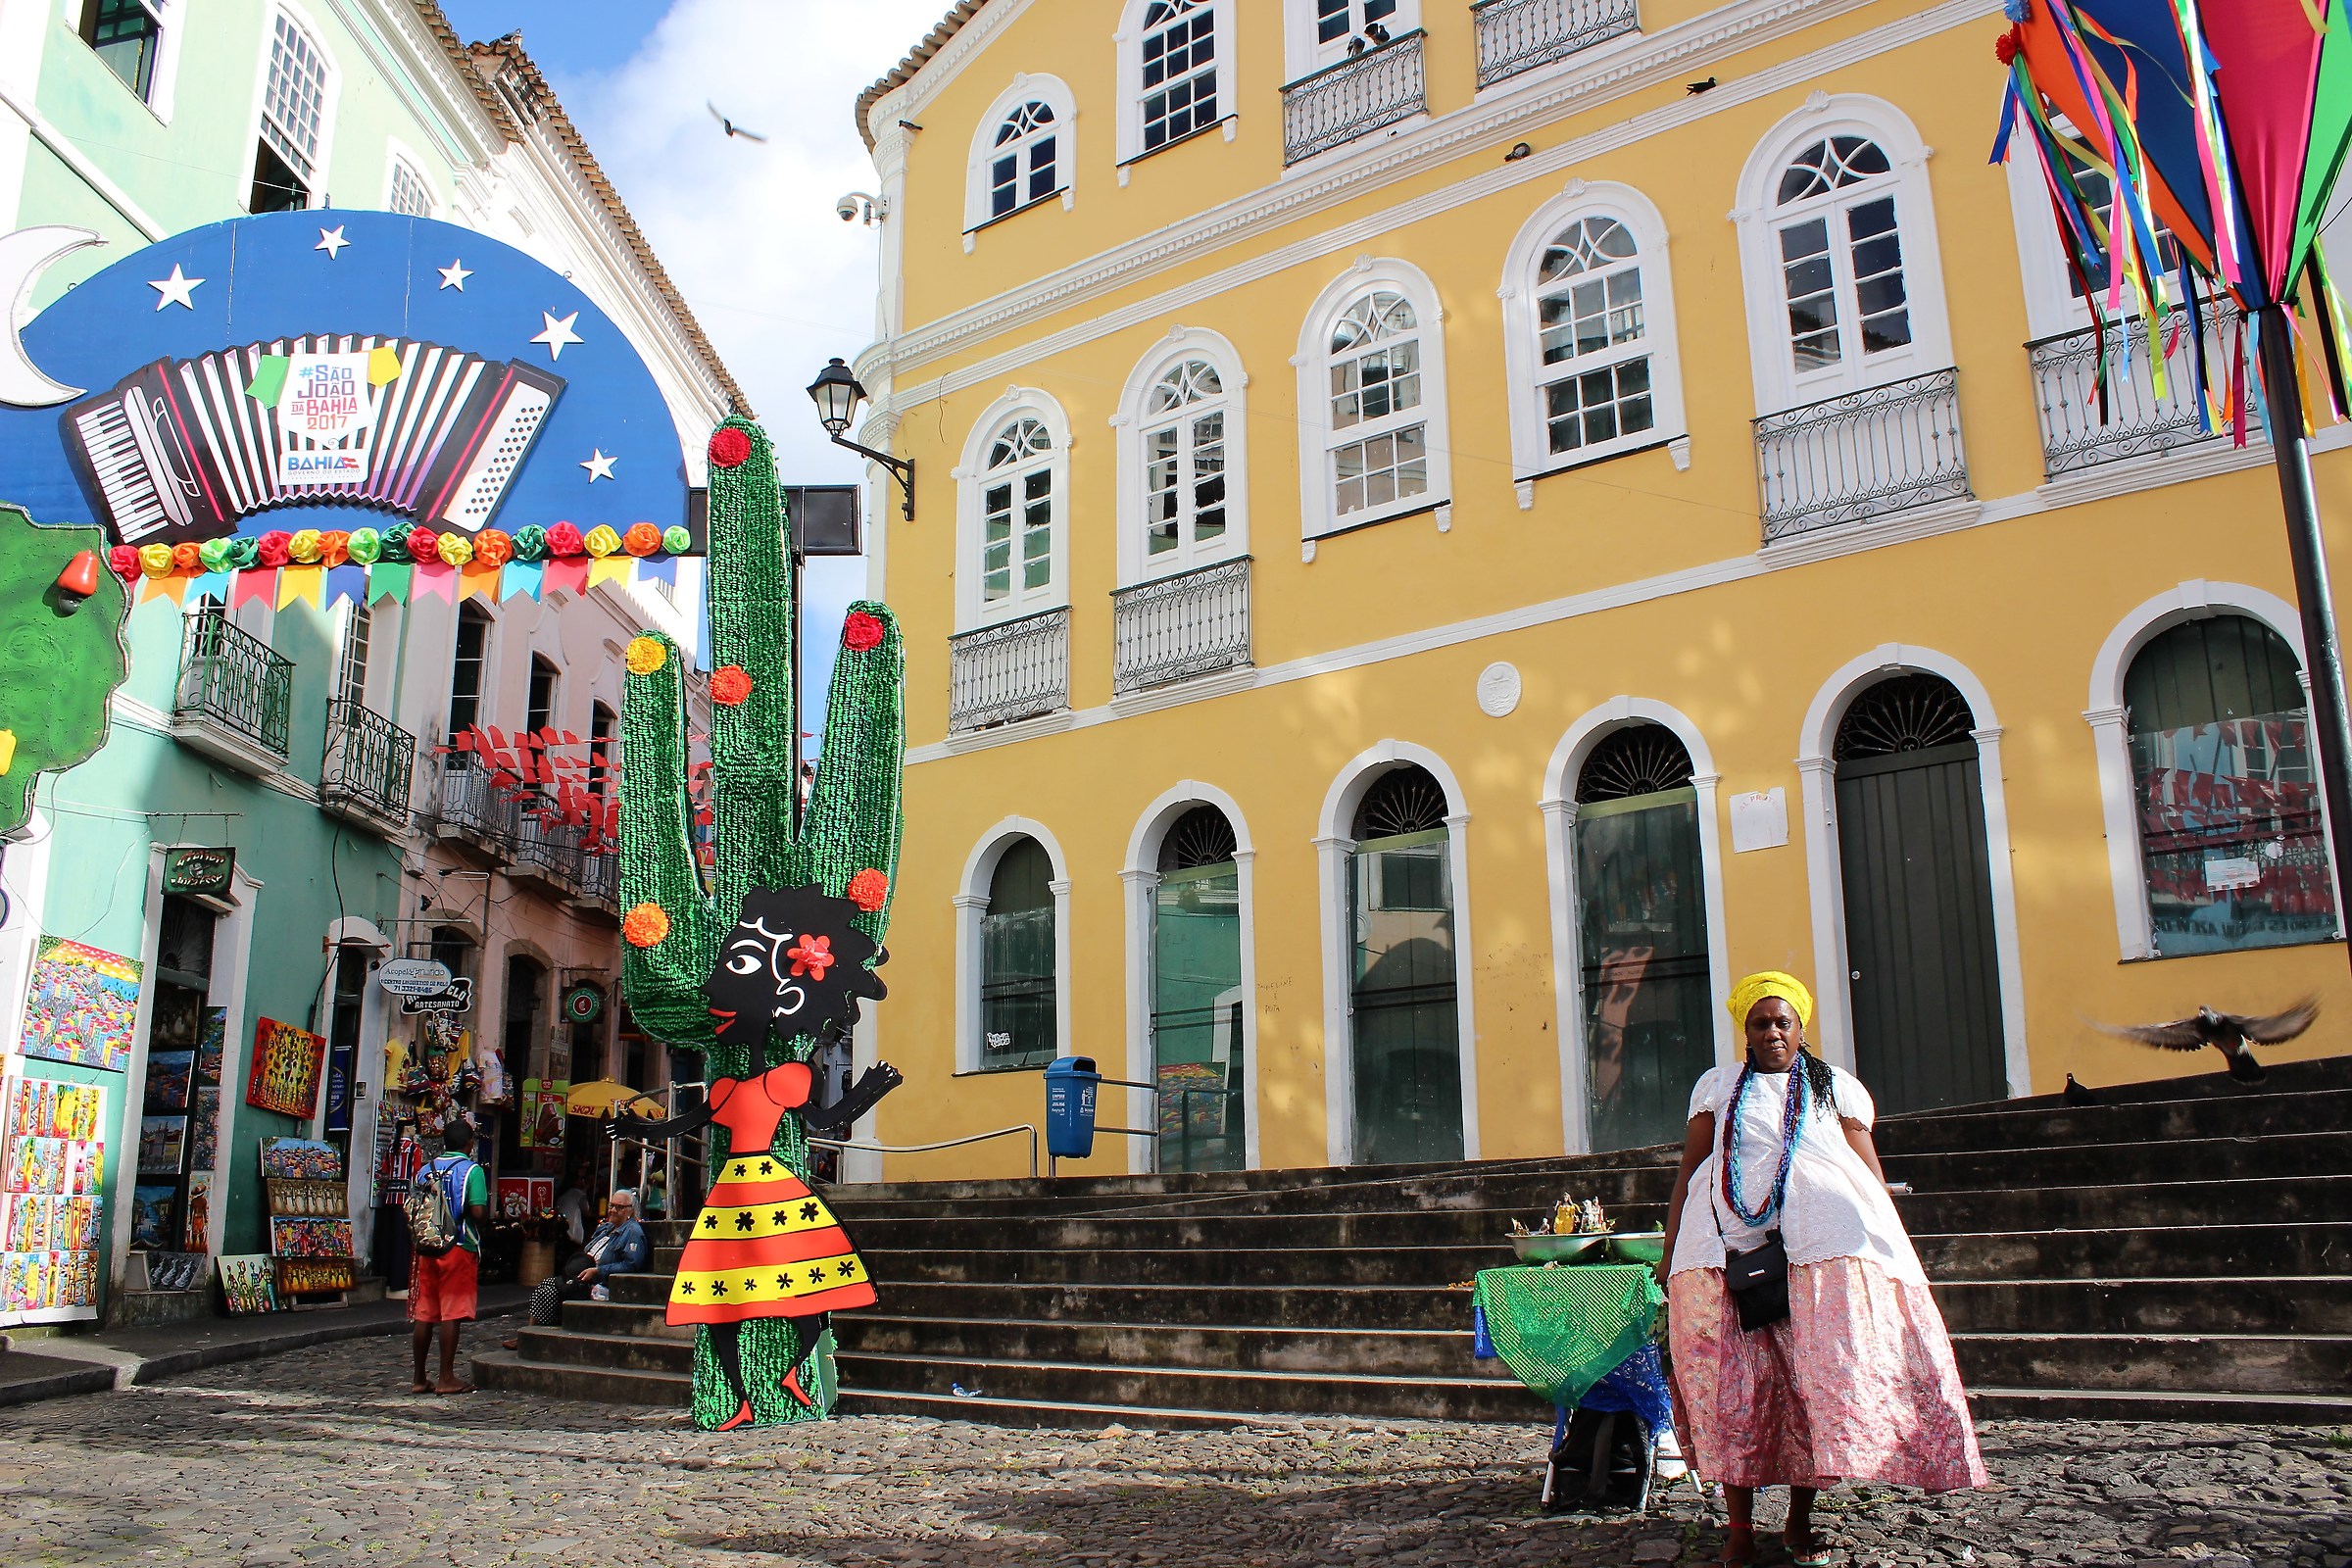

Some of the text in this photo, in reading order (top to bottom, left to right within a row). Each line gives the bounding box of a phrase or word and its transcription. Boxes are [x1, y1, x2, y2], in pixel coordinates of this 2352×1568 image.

[297, 378, 355, 399] JOÃO
[291, 397, 358, 416] DA BAHIA
[307, 413, 348, 430] 2017
[287, 456, 347, 470] BAHIA
[571, 1104, 595, 1115] SKOL
